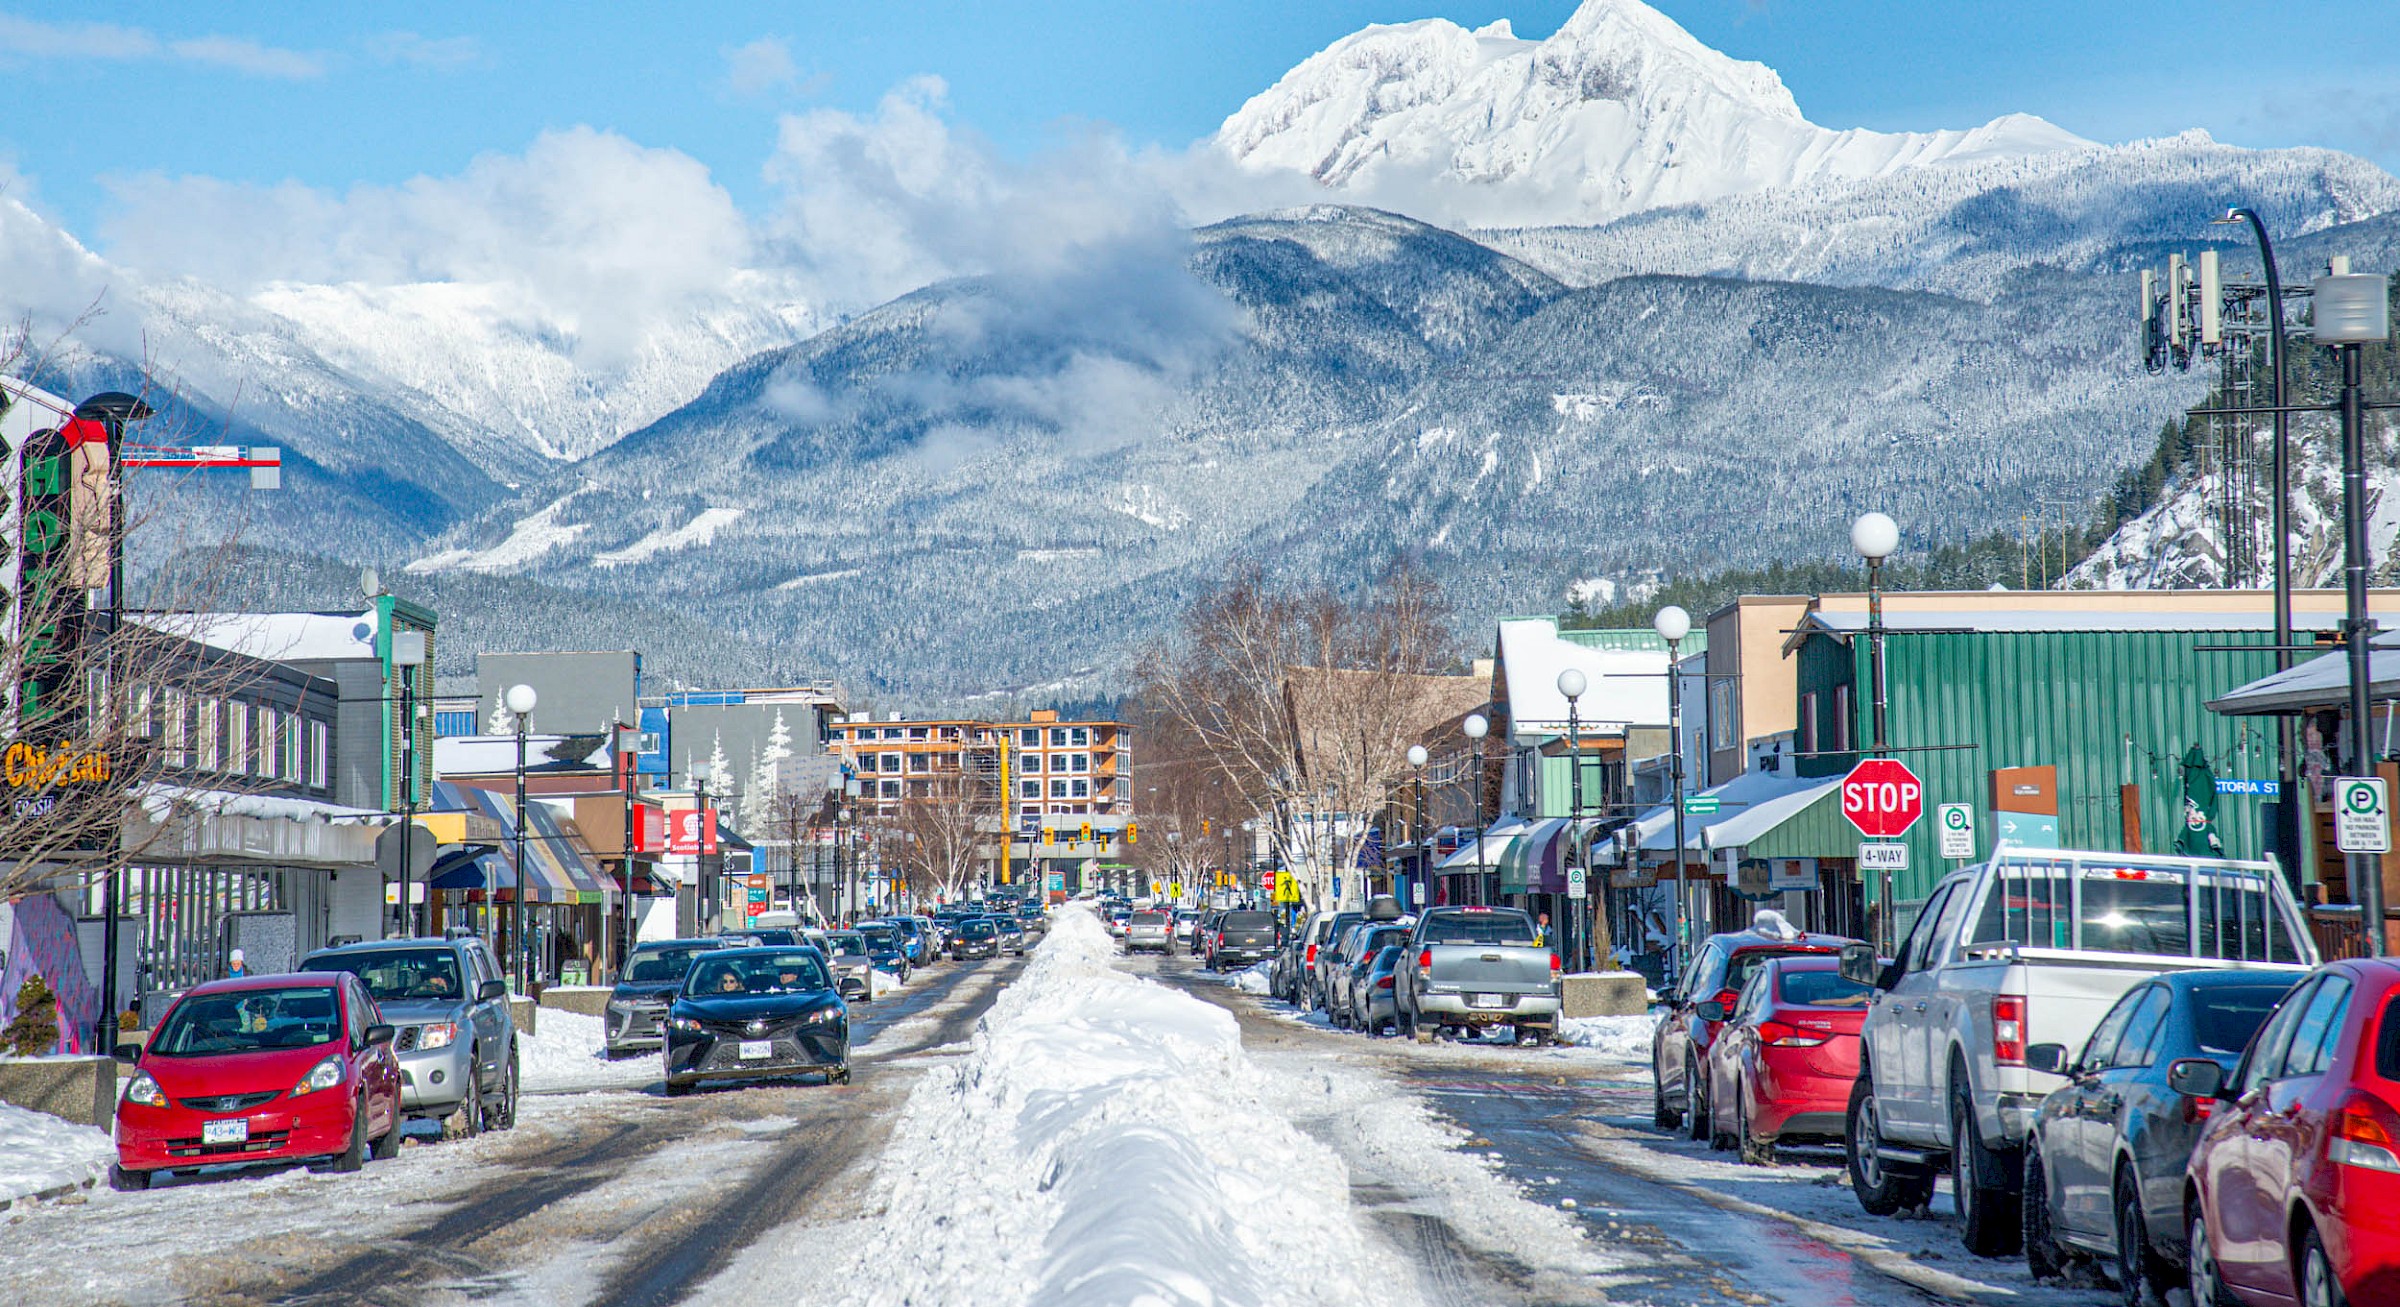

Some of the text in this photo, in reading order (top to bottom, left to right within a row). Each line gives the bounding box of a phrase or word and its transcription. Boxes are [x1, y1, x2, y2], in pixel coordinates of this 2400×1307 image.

[24, 456, 61, 719] HOTEL
[1845, 782, 1919, 813] STOP
[672, 843, 713, 852] Scotiabnk
[1865, 849, 1902, 863] 4-WAY
